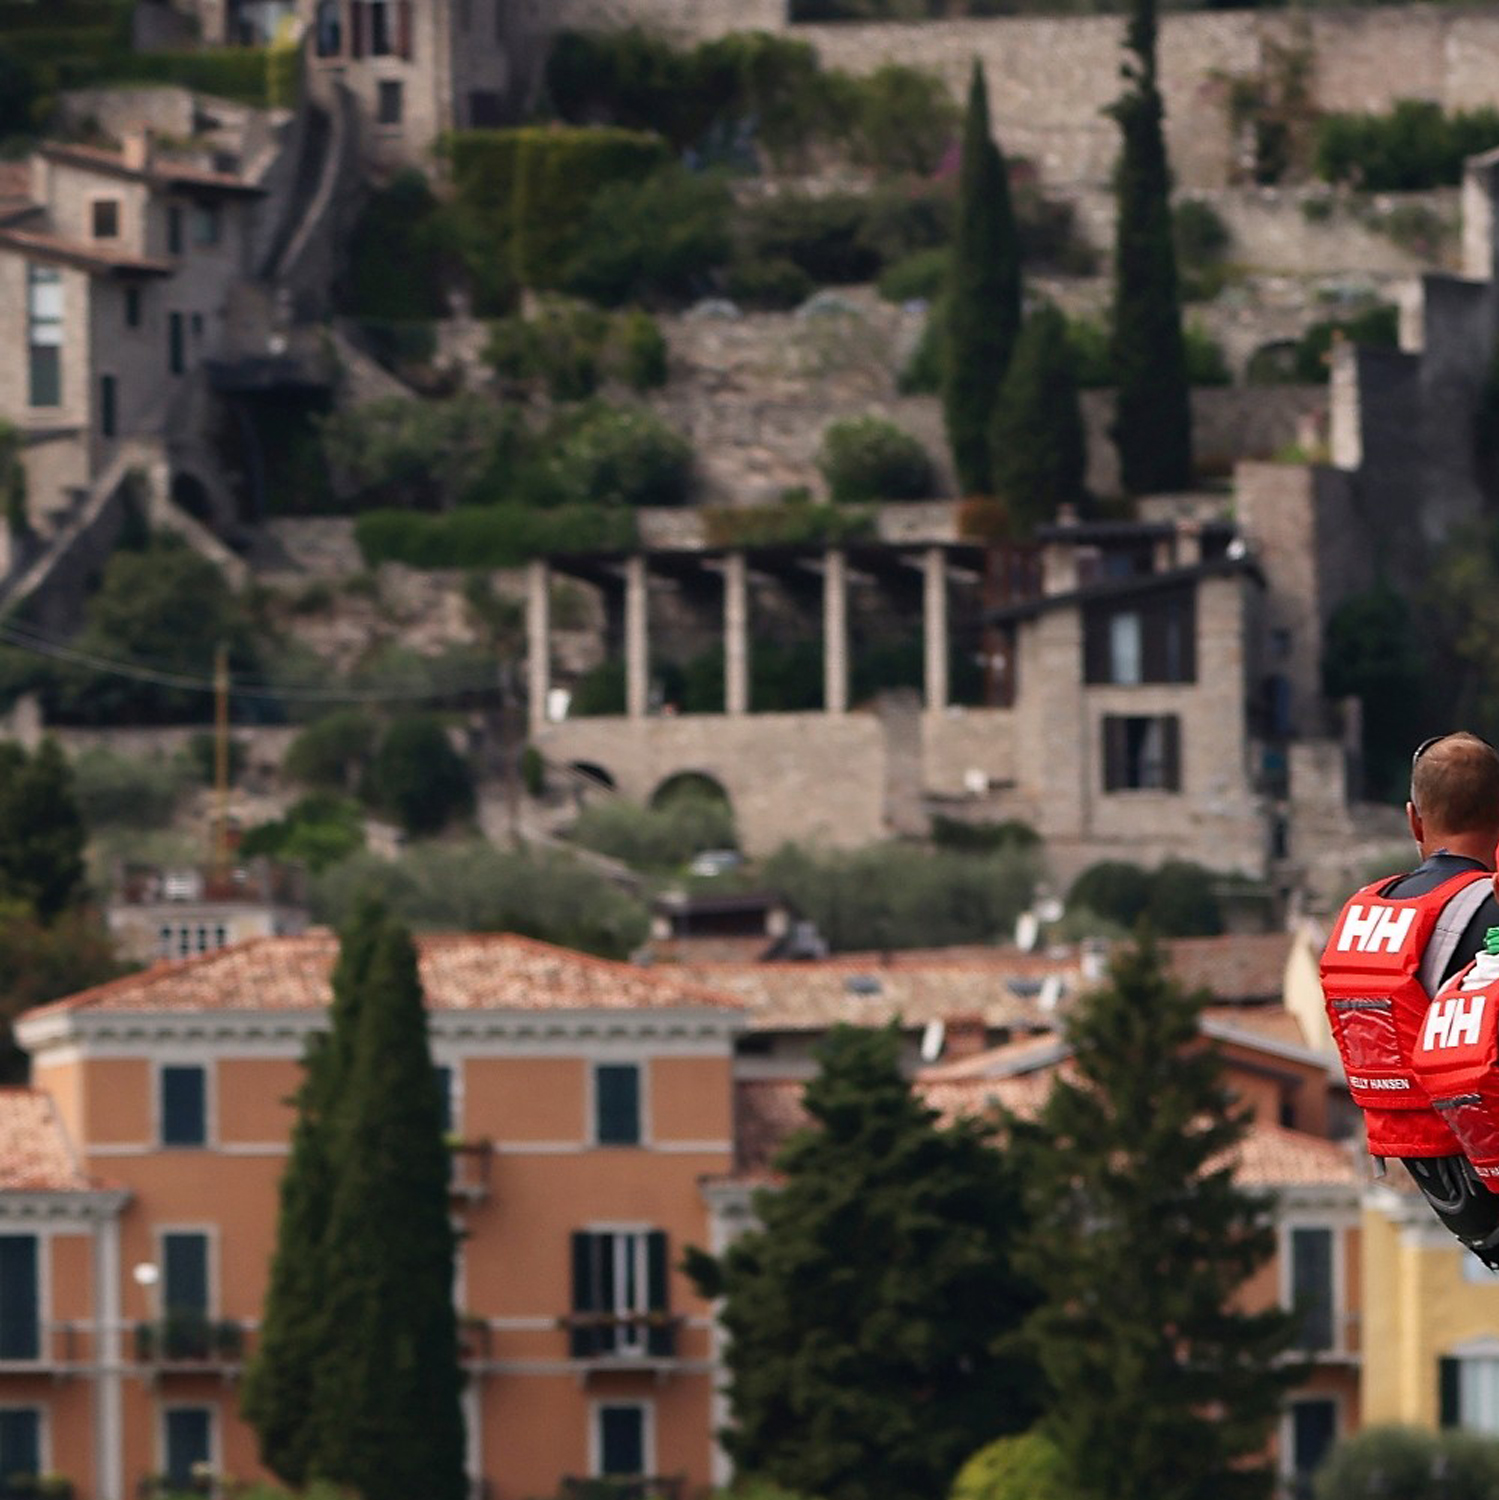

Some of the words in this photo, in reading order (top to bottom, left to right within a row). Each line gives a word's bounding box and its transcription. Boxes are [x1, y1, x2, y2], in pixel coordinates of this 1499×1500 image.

[1337, 905, 1417, 953] HH
[1423, 996, 1487, 1051] HH
[1370, 1079, 1410, 1090] HANSEN
